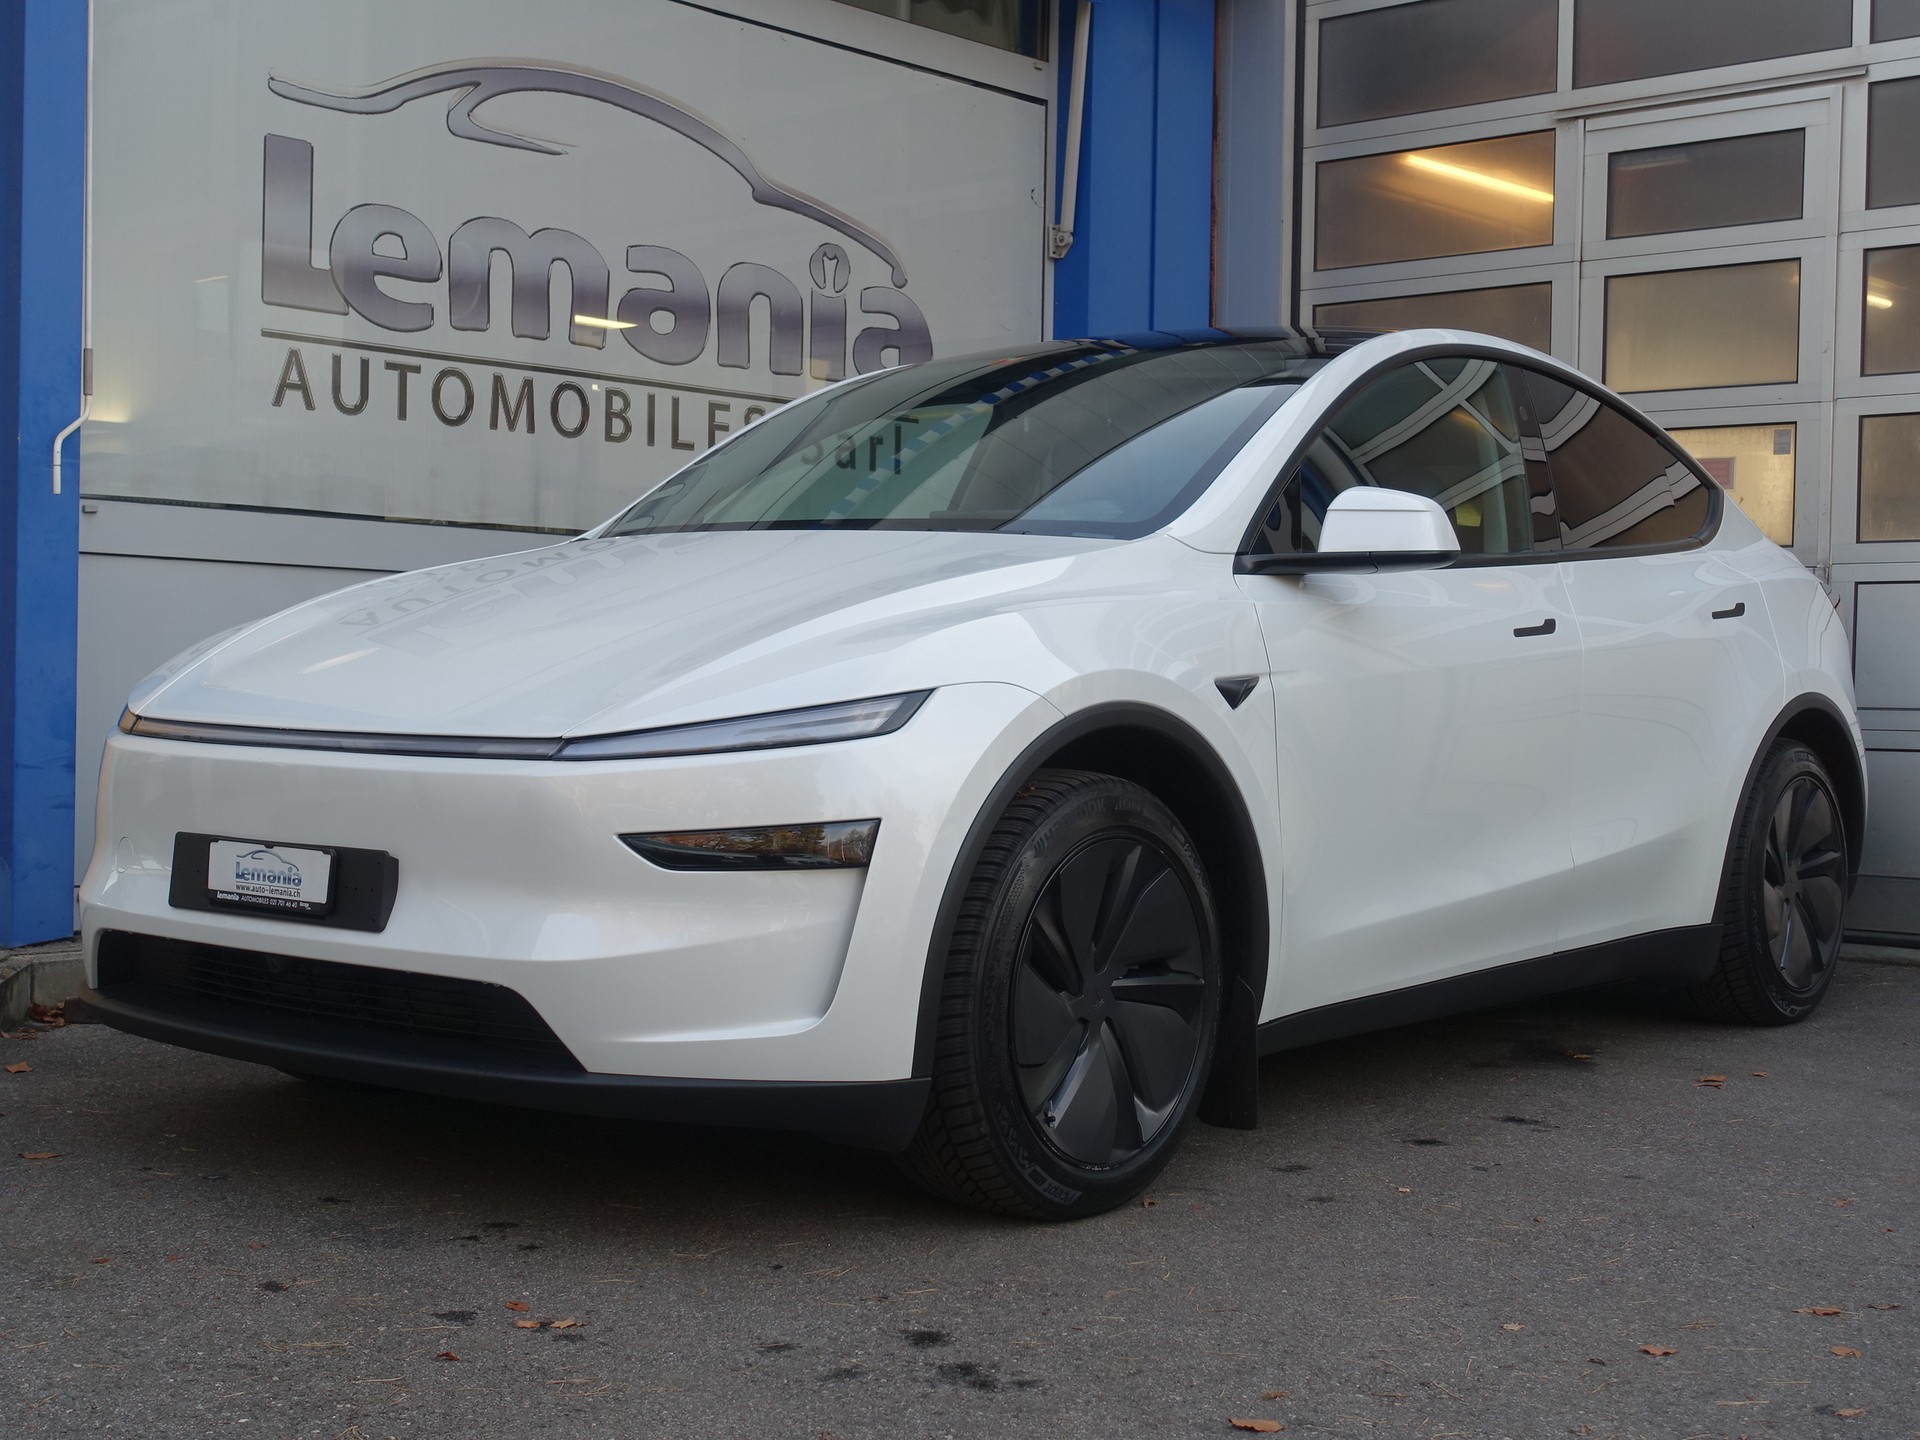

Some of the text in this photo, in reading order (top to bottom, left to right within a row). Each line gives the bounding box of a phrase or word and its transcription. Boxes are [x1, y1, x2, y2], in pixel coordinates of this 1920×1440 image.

[262, 133, 932, 382] Lemania
[235, 861, 302, 887] Lemania
[235, 883, 301, 898] www.auto-lemania.ch
